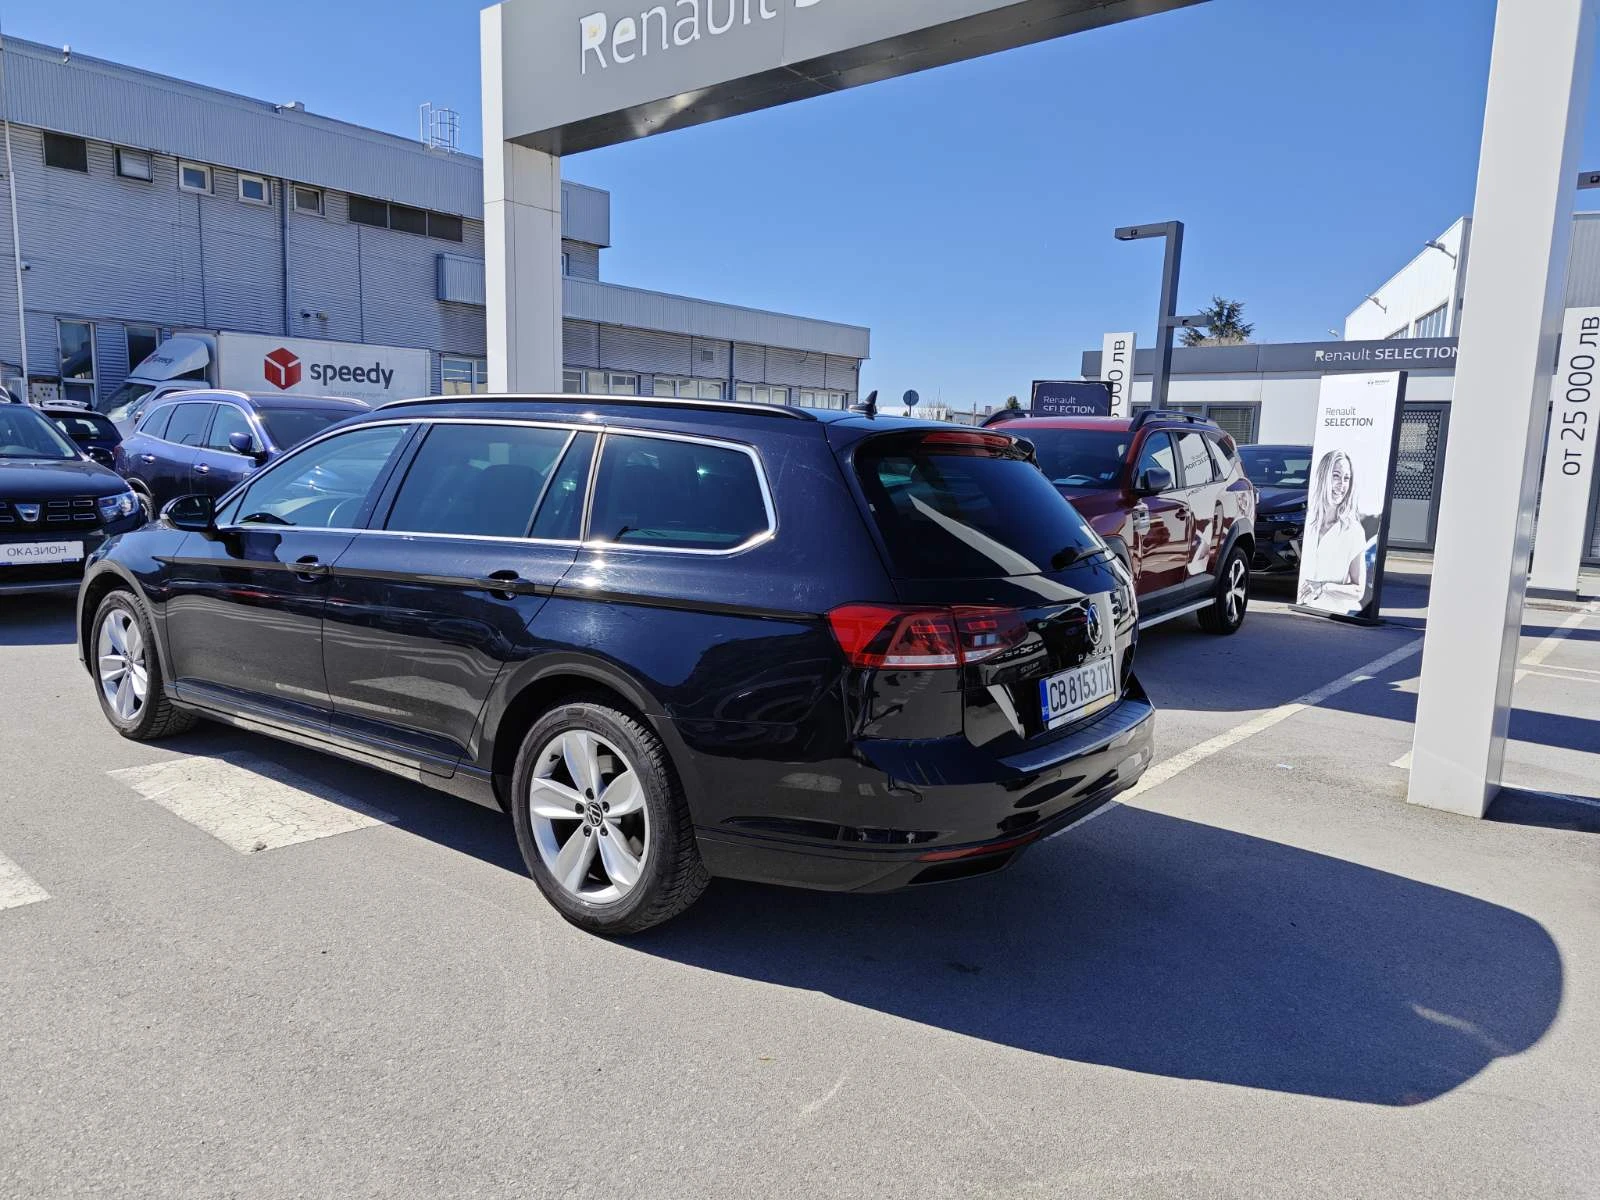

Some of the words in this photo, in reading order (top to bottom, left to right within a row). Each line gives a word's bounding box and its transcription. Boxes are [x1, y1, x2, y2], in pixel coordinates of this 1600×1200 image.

[1314, 347, 1371, 362] Renault
[310, 362, 394, 390] speedy
[1566, 355, 1596, 403] 000
[1043, 395, 1076, 405] Renault
[1043, 405, 1095, 414] SELECTION
[1325, 406, 1357, 416] Renault
[1324, 417, 1374, 427] SELECTION
[1560, 411, 1588, 441] 25
[7, 545, 67, 557] ОКАЗИОН
[1050, 679, 1068, 712] CB
[1069, 668, 1097, 705] 8153
[1098, 661, 1112, 692] TX
